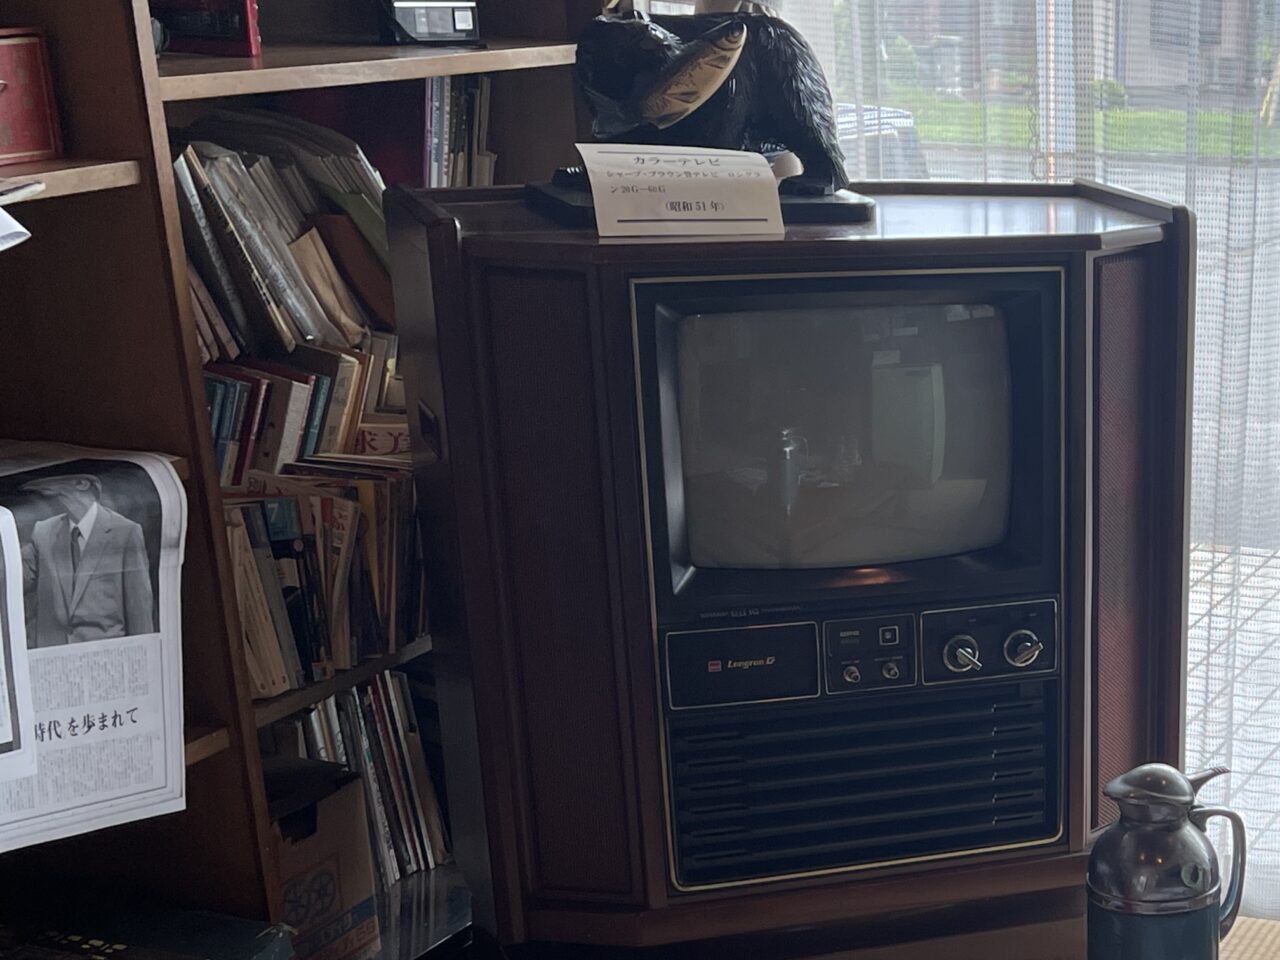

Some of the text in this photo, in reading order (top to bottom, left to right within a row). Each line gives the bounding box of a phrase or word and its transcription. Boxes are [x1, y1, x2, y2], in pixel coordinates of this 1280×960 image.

[633, 156, 721, 167] カラーテレビ
